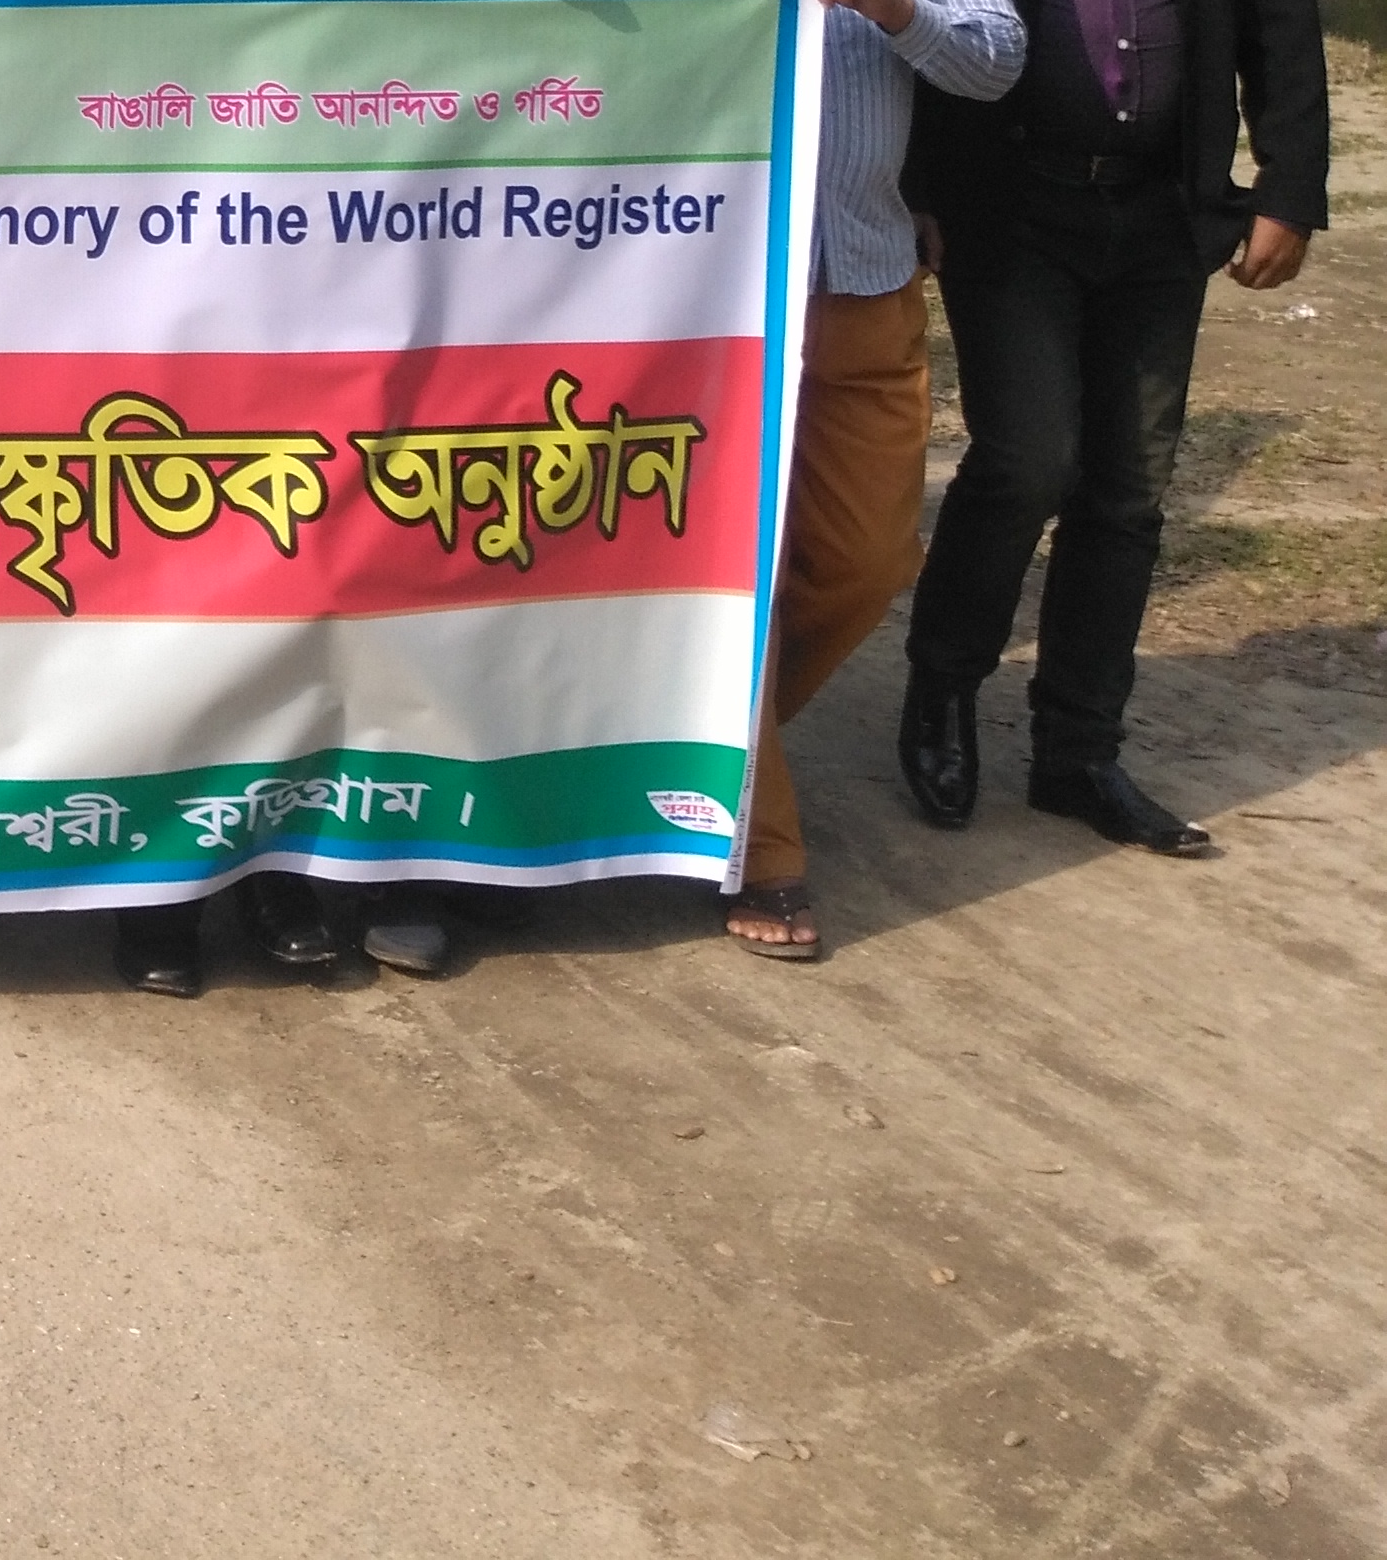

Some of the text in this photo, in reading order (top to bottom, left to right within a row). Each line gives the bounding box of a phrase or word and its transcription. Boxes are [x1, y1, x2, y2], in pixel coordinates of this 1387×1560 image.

[77, 77, 604, 129] বাঙালি জাতি আনন্দিত ও গর্বিত
[139, 190, 200, 245] of
[216, 191, 308, 246] the
[327, 186, 483, 244] World
[503, 183, 726, 250] Register
[349, 370, 706, 573] অনুষ্ঠান
[174, 773, 433, 850] কুড়িগ্রাম
